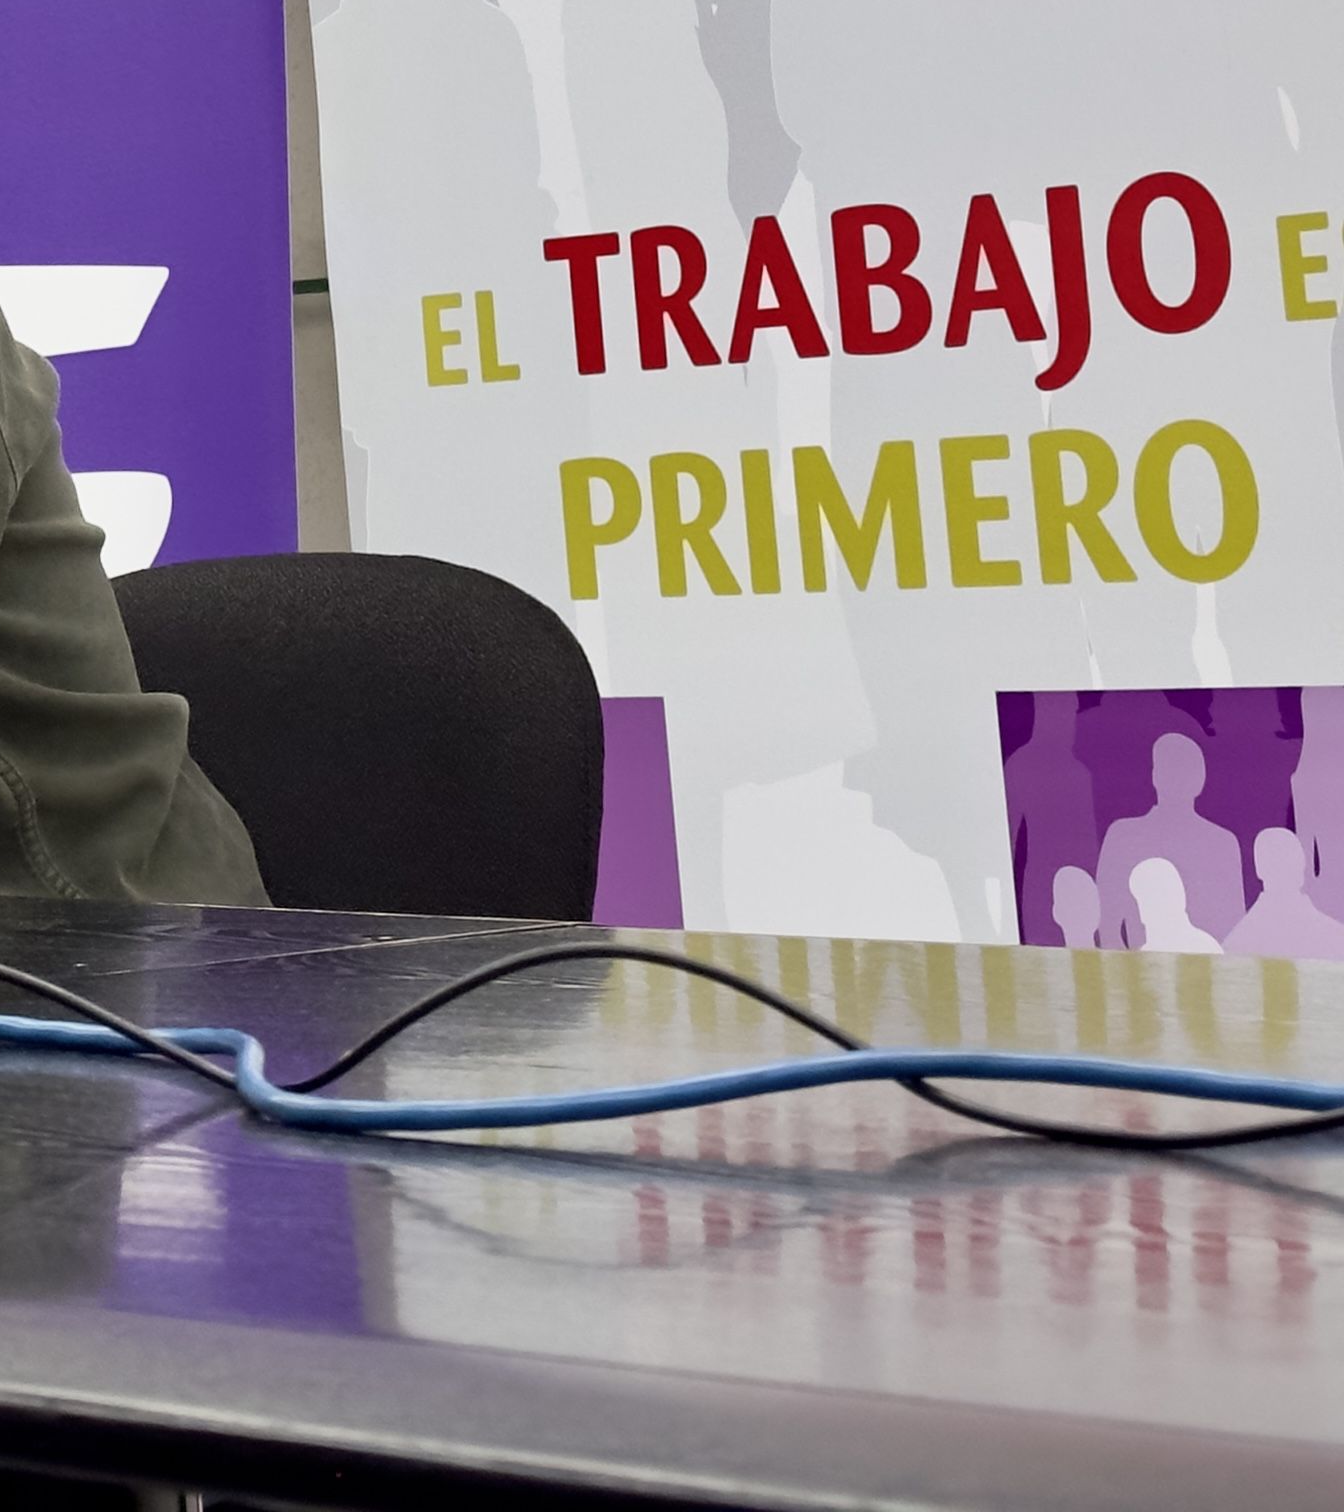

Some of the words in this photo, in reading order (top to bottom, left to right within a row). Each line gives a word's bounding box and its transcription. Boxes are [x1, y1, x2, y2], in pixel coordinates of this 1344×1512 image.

[421, 290, 521, 387] EL
[542, 171, 1232, 391] TRABAJO
[1276, 210, 1344, 323] E
[559, 419, 1261, 601] PRIMERO
